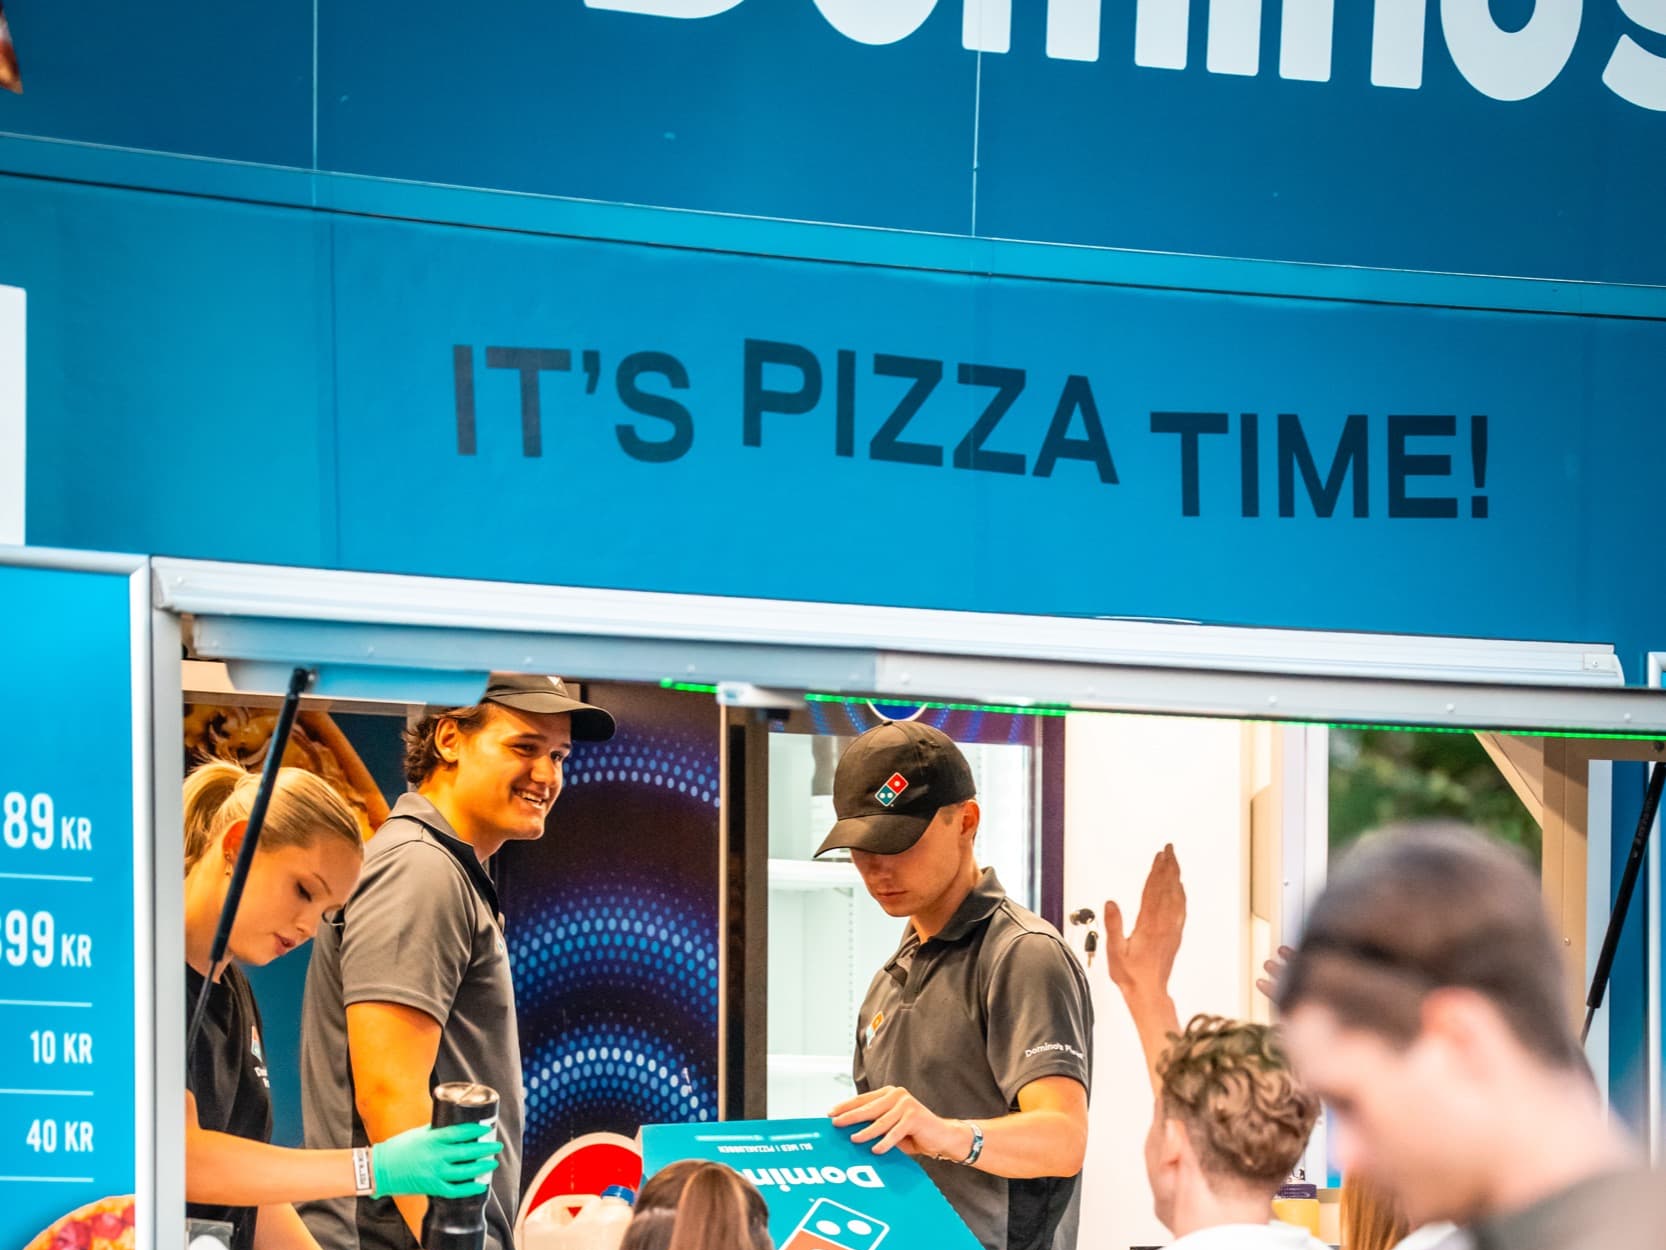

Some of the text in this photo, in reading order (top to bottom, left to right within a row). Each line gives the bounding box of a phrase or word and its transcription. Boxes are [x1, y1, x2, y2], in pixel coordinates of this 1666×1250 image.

[452, 338, 1488, 518] IT'S PIZZA TIME!
[3, 791, 92, 850] 89 KR
[0, 909, 92, 968] 99 KR
[30, 1030, 93, 1064] 10 KR
[26, 1119, 94, 1152] 40 KR
[739, 1165, 885, 1192] Domin
